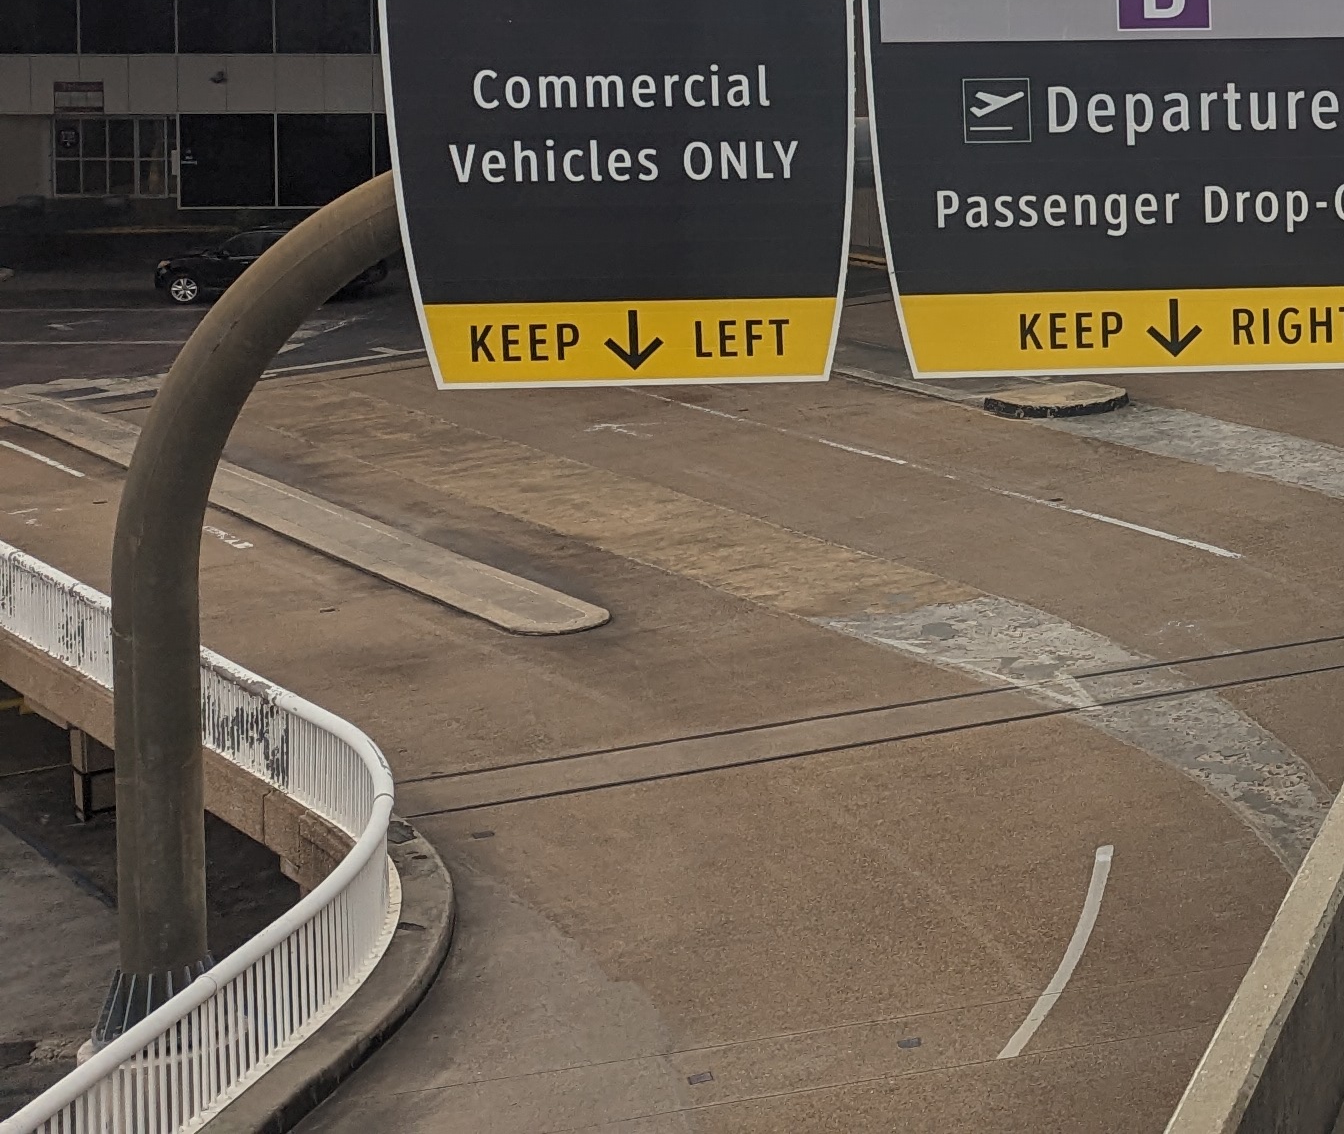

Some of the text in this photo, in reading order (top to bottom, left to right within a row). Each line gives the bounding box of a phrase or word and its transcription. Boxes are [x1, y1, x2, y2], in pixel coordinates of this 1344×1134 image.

[473, 64, 770, 110] Commercial
[448, 139, 799, 183] Vehicles ONLY
[936, 190, 1180, 237] Passenger
[470, 318, 790, 363] KEEP LEFT
[1019, 311, 1123, 351] KEEP
